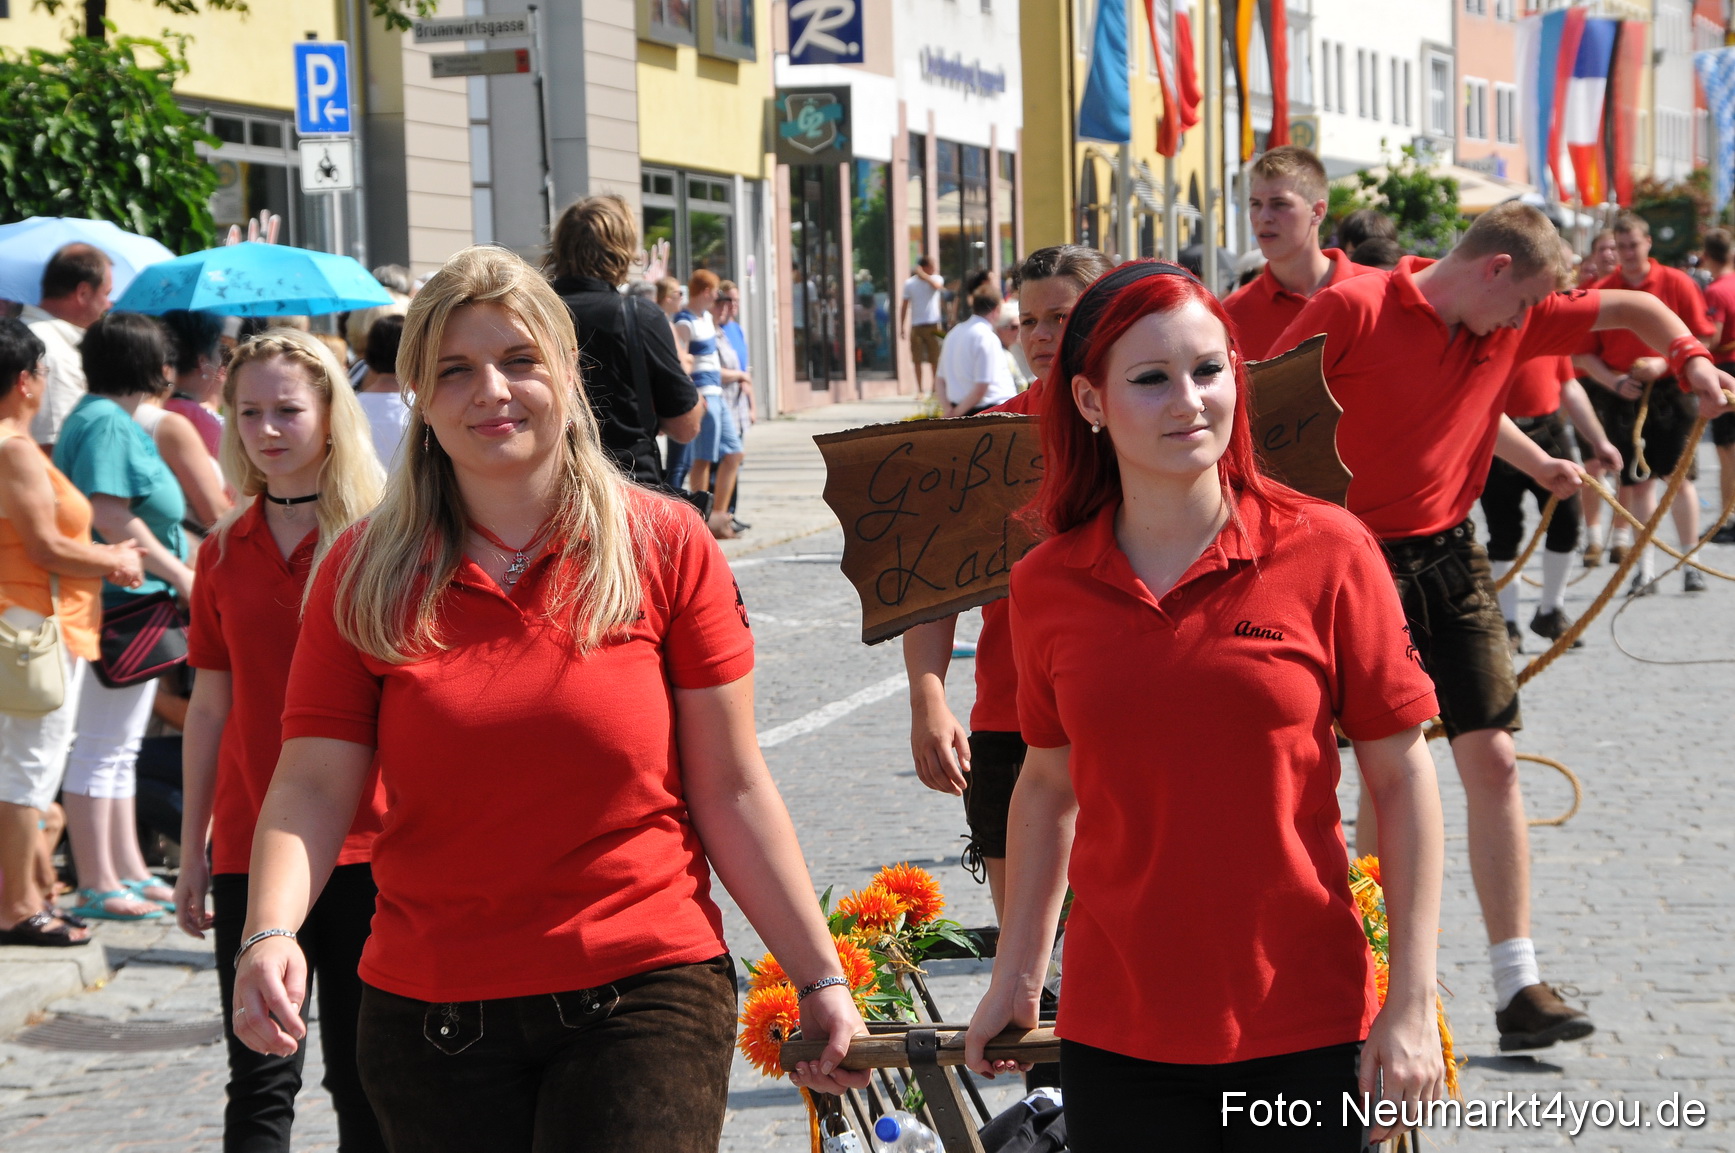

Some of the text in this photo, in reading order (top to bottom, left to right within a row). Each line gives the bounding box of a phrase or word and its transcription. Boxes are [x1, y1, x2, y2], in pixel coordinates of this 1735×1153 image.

[415, 18, 526, 38] Brunnwirtsgasse
[305, 53, 339, 123] P
[1234, 620, 1284, 641] Anna
